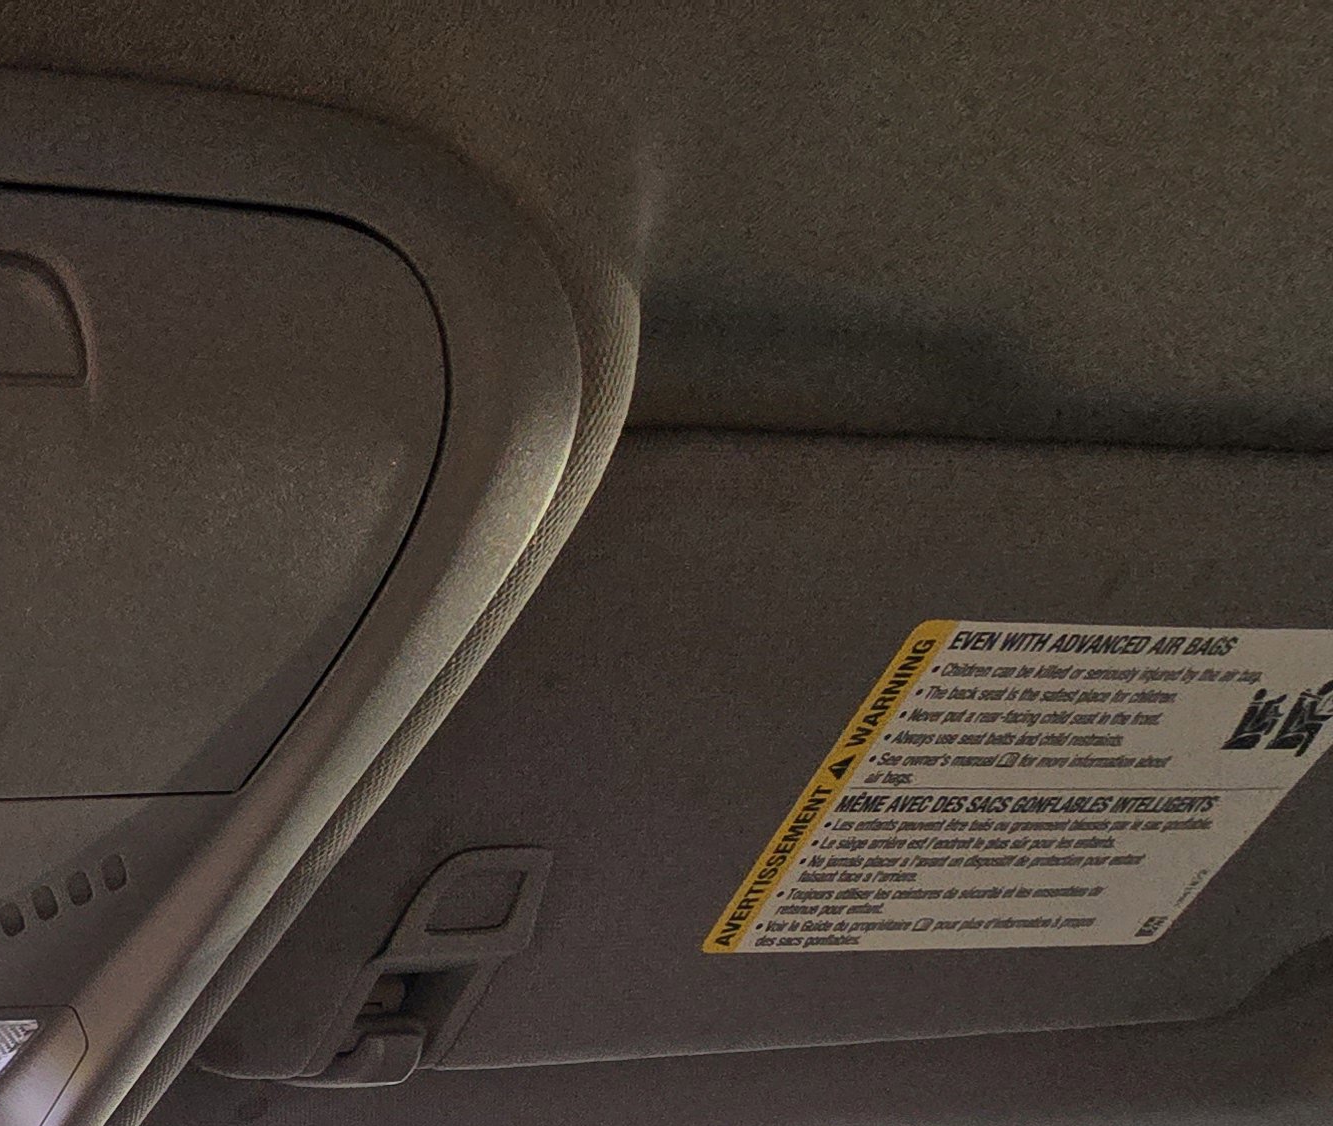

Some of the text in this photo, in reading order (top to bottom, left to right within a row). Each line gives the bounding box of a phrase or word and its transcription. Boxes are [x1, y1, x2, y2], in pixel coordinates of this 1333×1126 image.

[949, 631, 1239, 657] EVEN WITH ADVANCED AIR BAGS
[845, 638, 936, 748] WARNING
[835, 793, 1221, 813] MÊME AVEC DES SACS GONFLABLES INTELLIGENTS
[715, 785, 833, 947] AVERTISSEMENT
